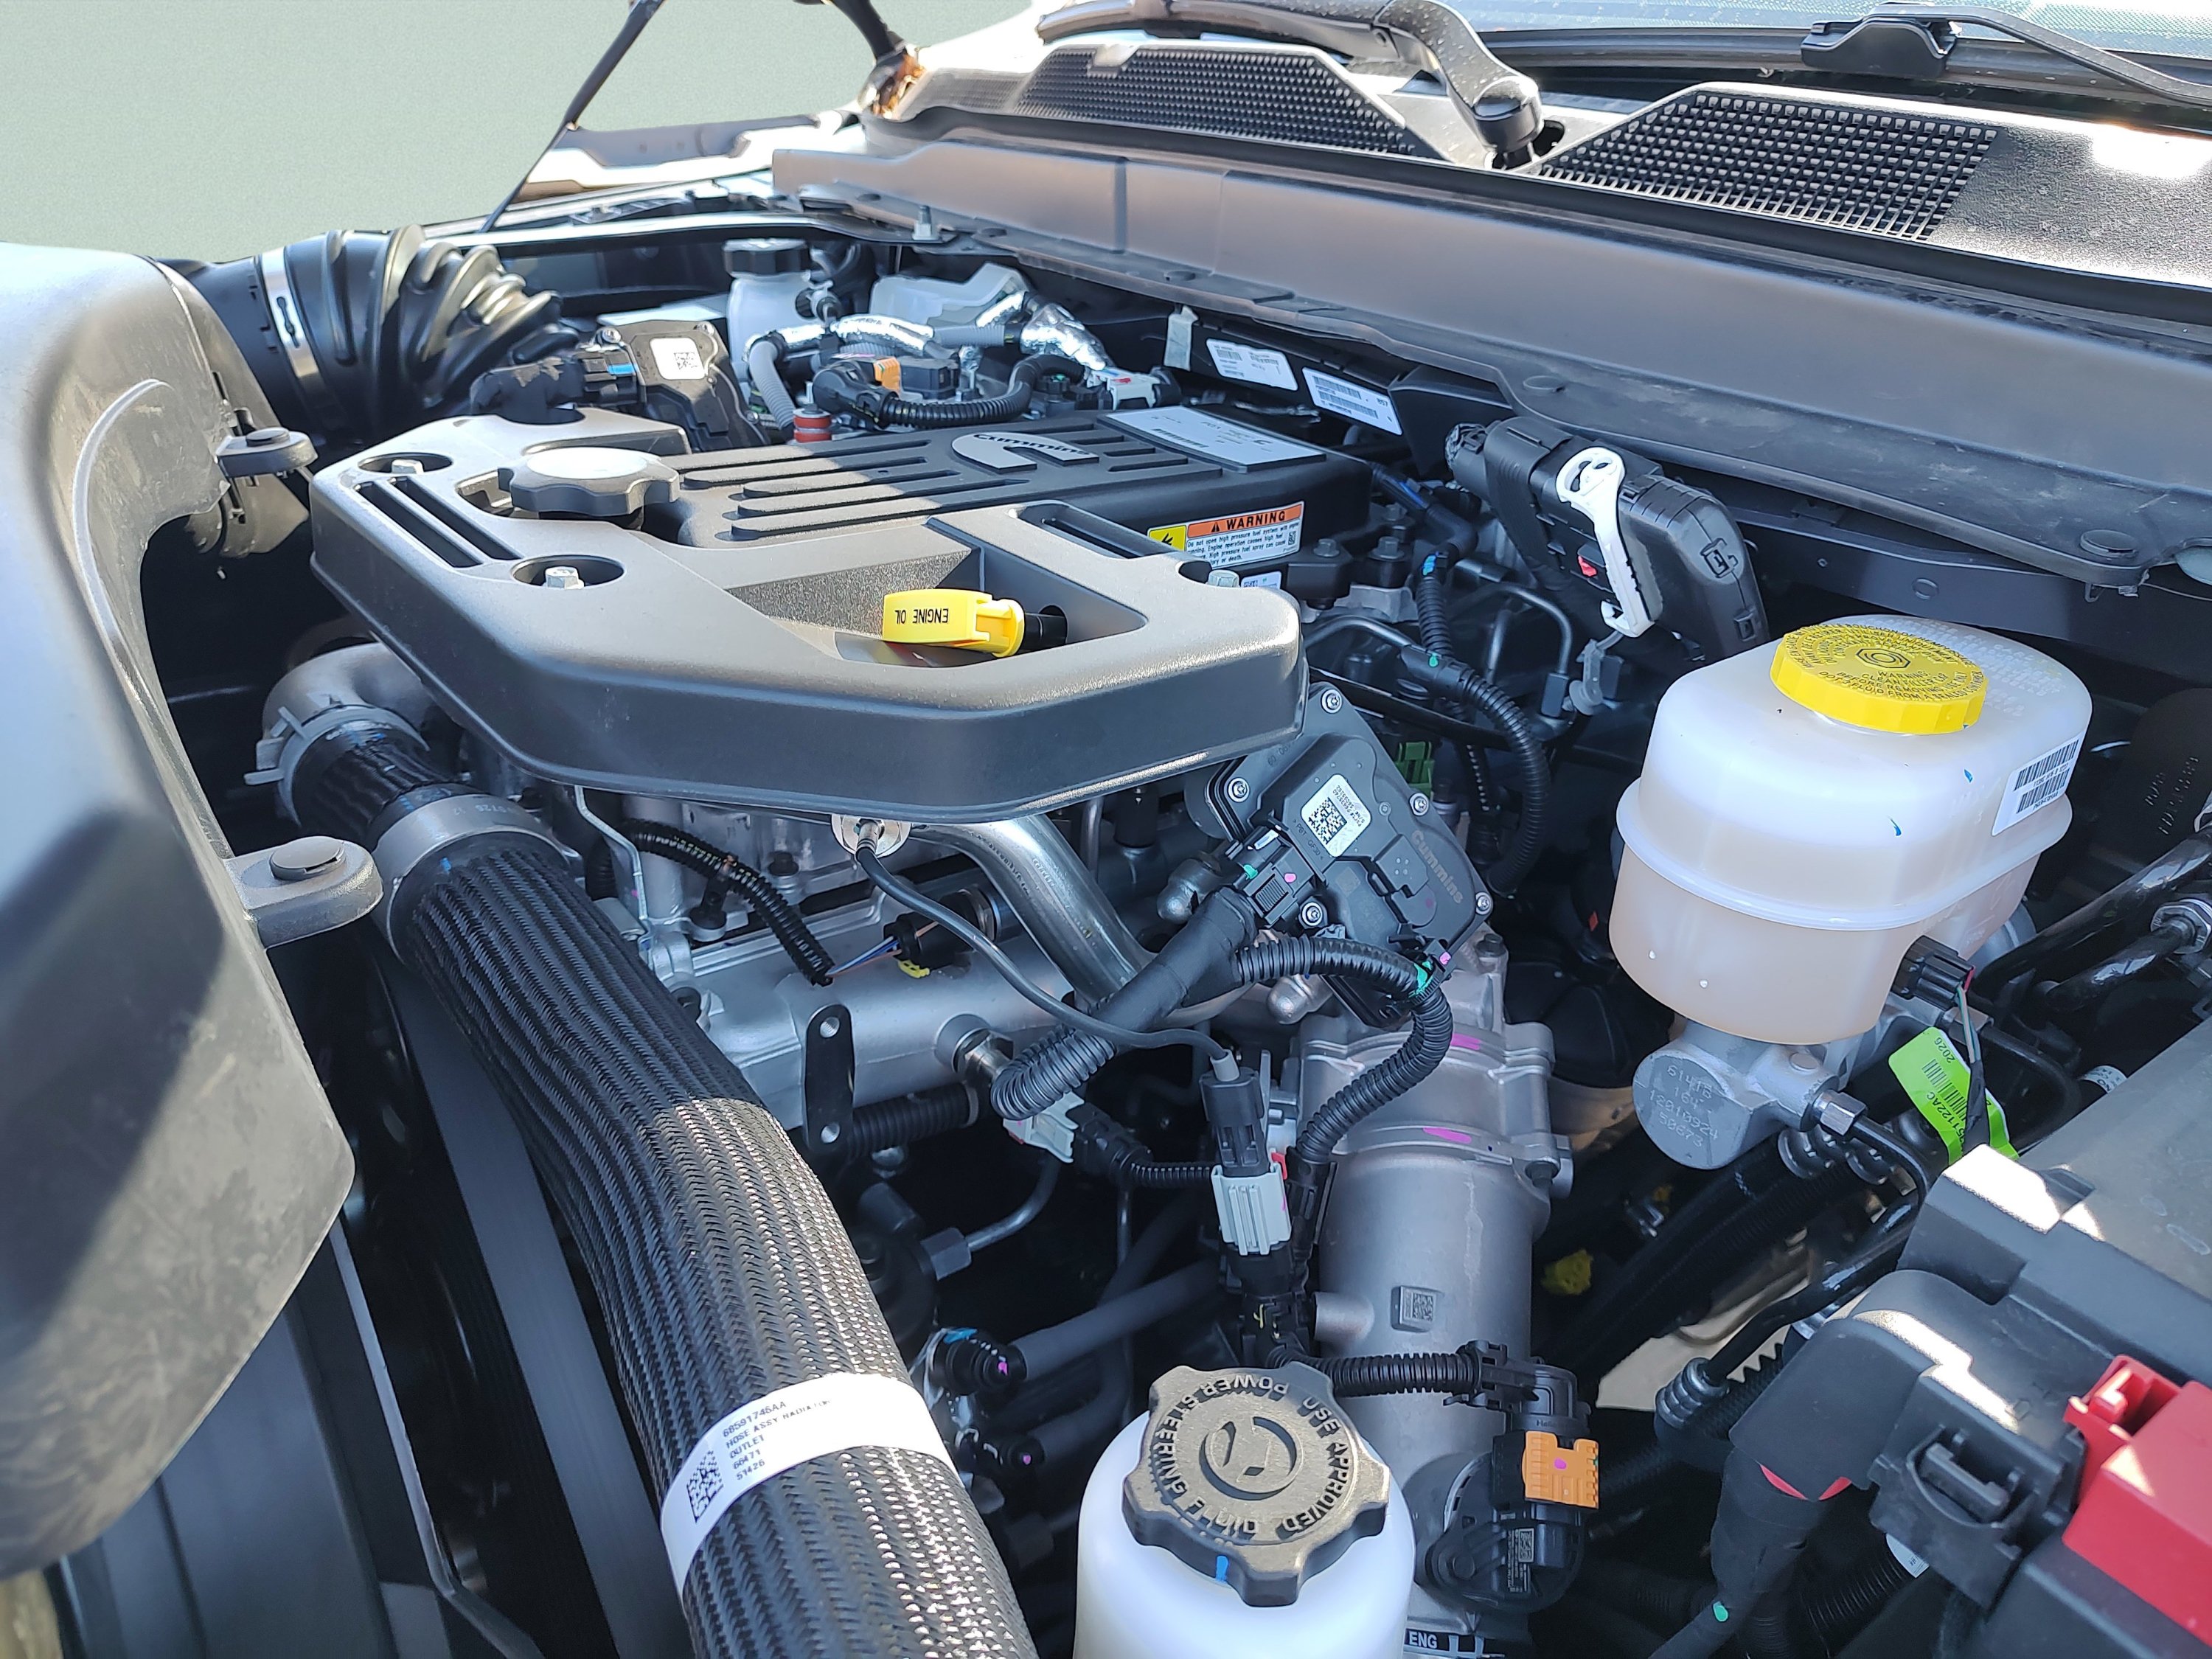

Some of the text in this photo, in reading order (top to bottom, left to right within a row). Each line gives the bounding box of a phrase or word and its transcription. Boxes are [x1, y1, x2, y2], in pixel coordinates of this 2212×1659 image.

[973, 434, 1091, 455] Cummins
[1227, 510, 1285, 530] WARNING
[1231, 532, 1251, 540] pressure
[1221, 548, 1240, 557] pressure
[894, 608, 949, 625] ENGINE OIL
[1819, 672, 1843, 681] DOT
[1851, 683, 1884, 694] FLUID
[1888, 690, 1920, 699] FROM
[1837, 672, 1882, 687] BEFORE
[1862, 674, 1900, 685] CLEAN
[1411, 830, 1464, 904] Cummins
[1934, 1037, 1955, 1063] 2026
[726, 1429, 751, 1449] HOSE
[754, 1417, 778, 1432] ASSY
[730, 1434, 765, 1459] OUTLET
[1153, 1374, 1289, 1536] POWER STEERING FLUID
[1281, 1398, 1350, 1534] USE APPROVED
[1408, 1630, 1438, 1649] ENG
